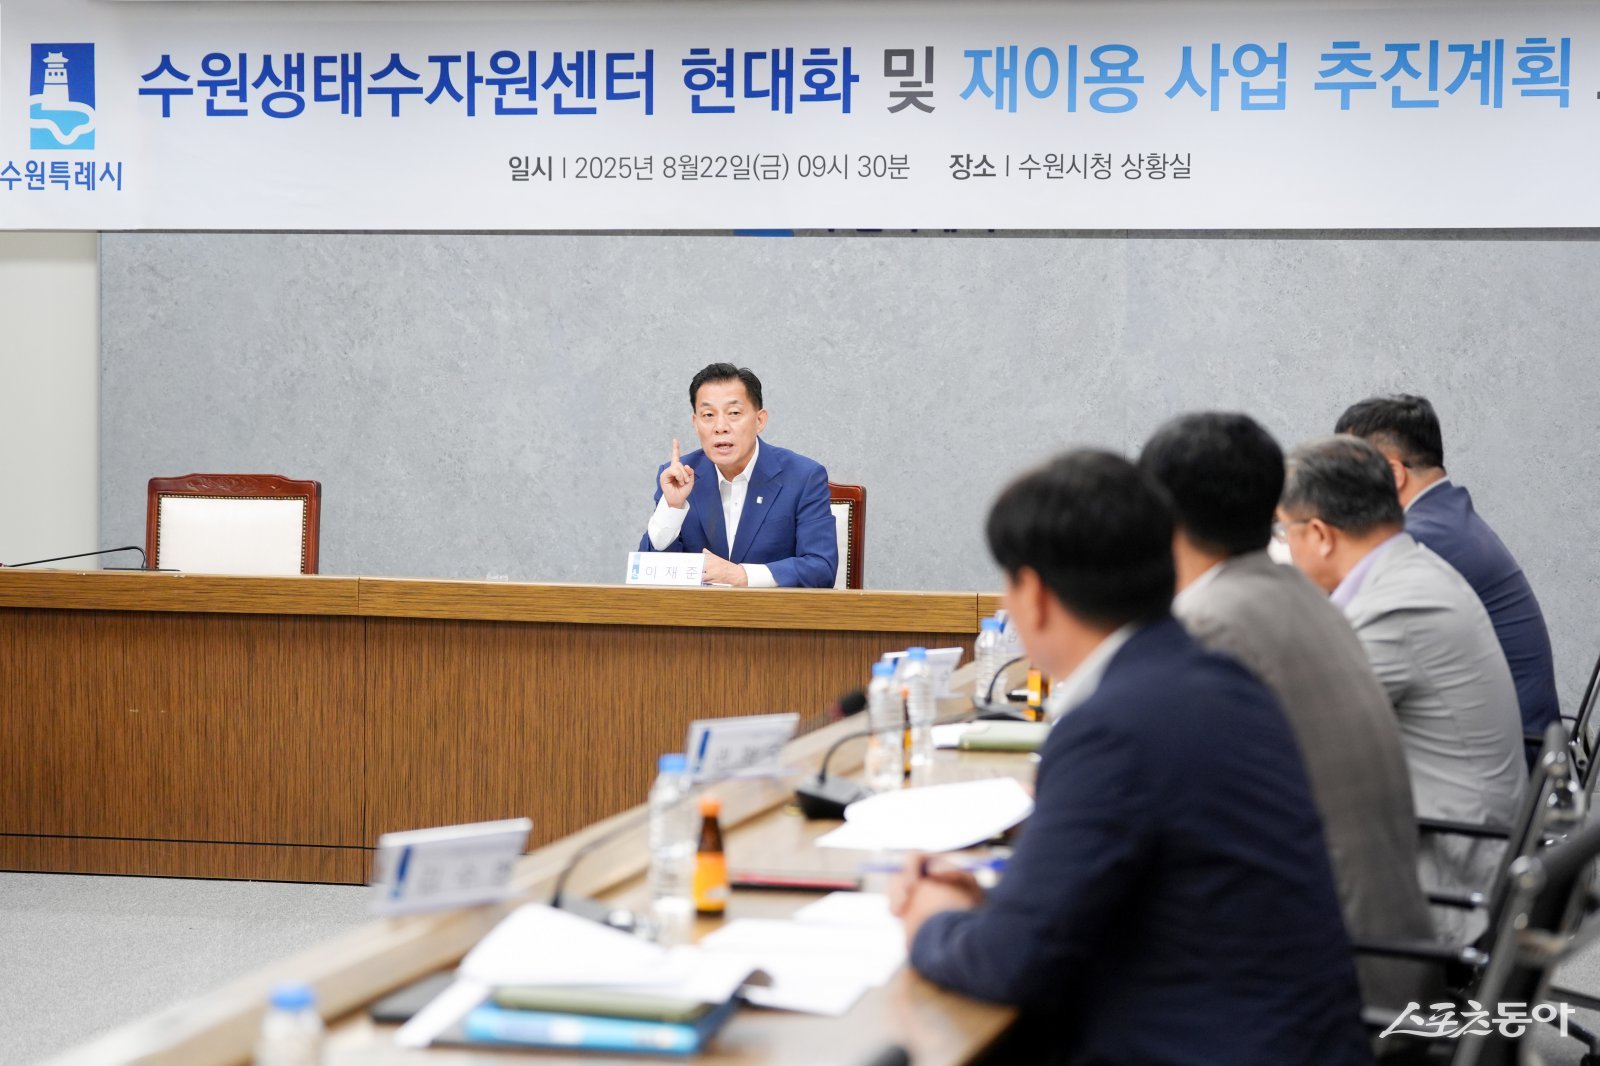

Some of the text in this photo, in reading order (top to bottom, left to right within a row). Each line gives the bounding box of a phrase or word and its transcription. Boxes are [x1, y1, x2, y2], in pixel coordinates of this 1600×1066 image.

[138, 37, 1571, 118] 수원생태수자원센터 현대화 및 재이용 사업 추진계획
[0, 158, 123, 192] 수원특례시
[508, 155, 553, 182] 일시
[574, 154, 654, 181] 2025년
[797, 153, 848, 180] 09시
[857, 153, 911, 180] 30분
[948, 153, 997, 180] 장소
[1018, 152, 1112, 180] 수원시청
[1120, 152, 1191, 180] 상황실
